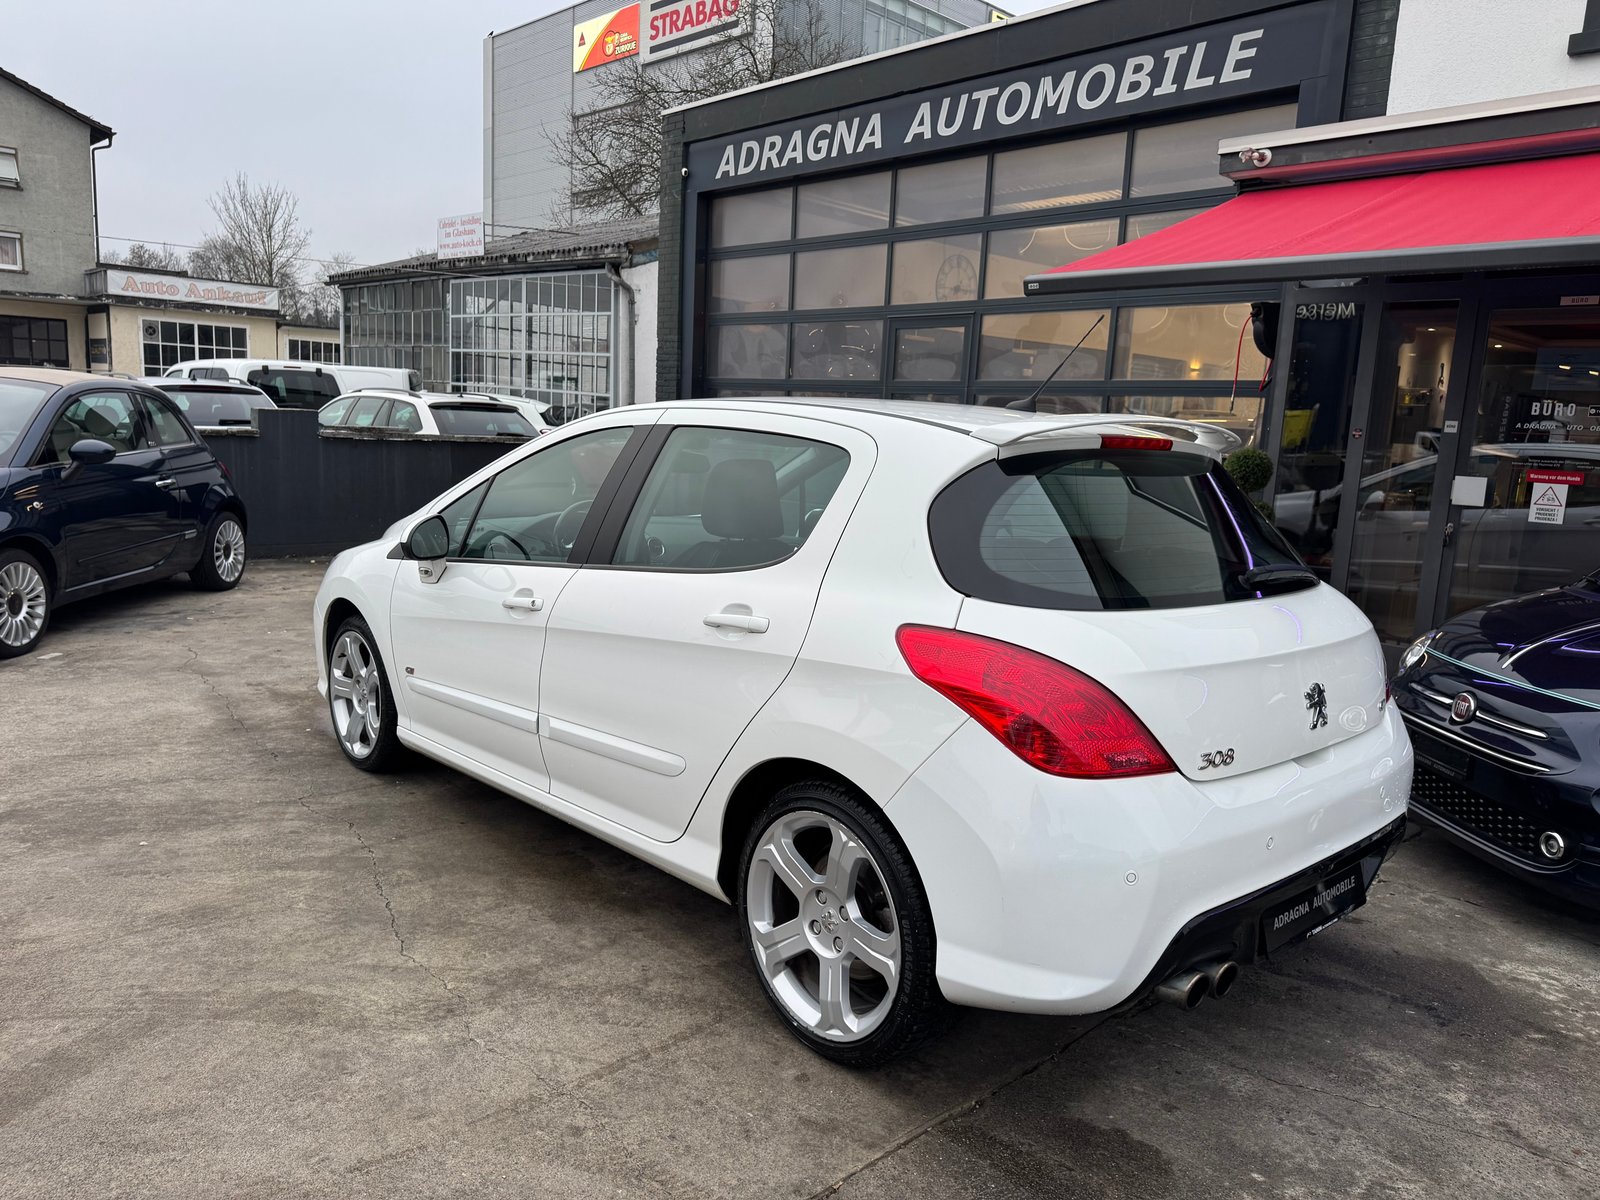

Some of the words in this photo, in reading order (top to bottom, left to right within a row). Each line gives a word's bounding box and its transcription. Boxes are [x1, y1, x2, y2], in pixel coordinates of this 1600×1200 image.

[649, 0, 740, 40] STRABAG
[715, 113, 883, 179] ADRAGNA
[904, 28, 1264, 143] AUTOMOBILE
[121, 275, 179, 297] Auto
[185, 282, 266, 305] Ankauf
[1531, 400, 1576, 417] BÜRO
[1455, 701, 1469, 714] FIAT
[1198, 748, 1235, 770] 308
[1273, 901, 1310, 931] ADRAGNA
[1312, 875, 1356, 909] AUTOMOBILE
[902, 920, 913, 993] ULTRAGRIP
